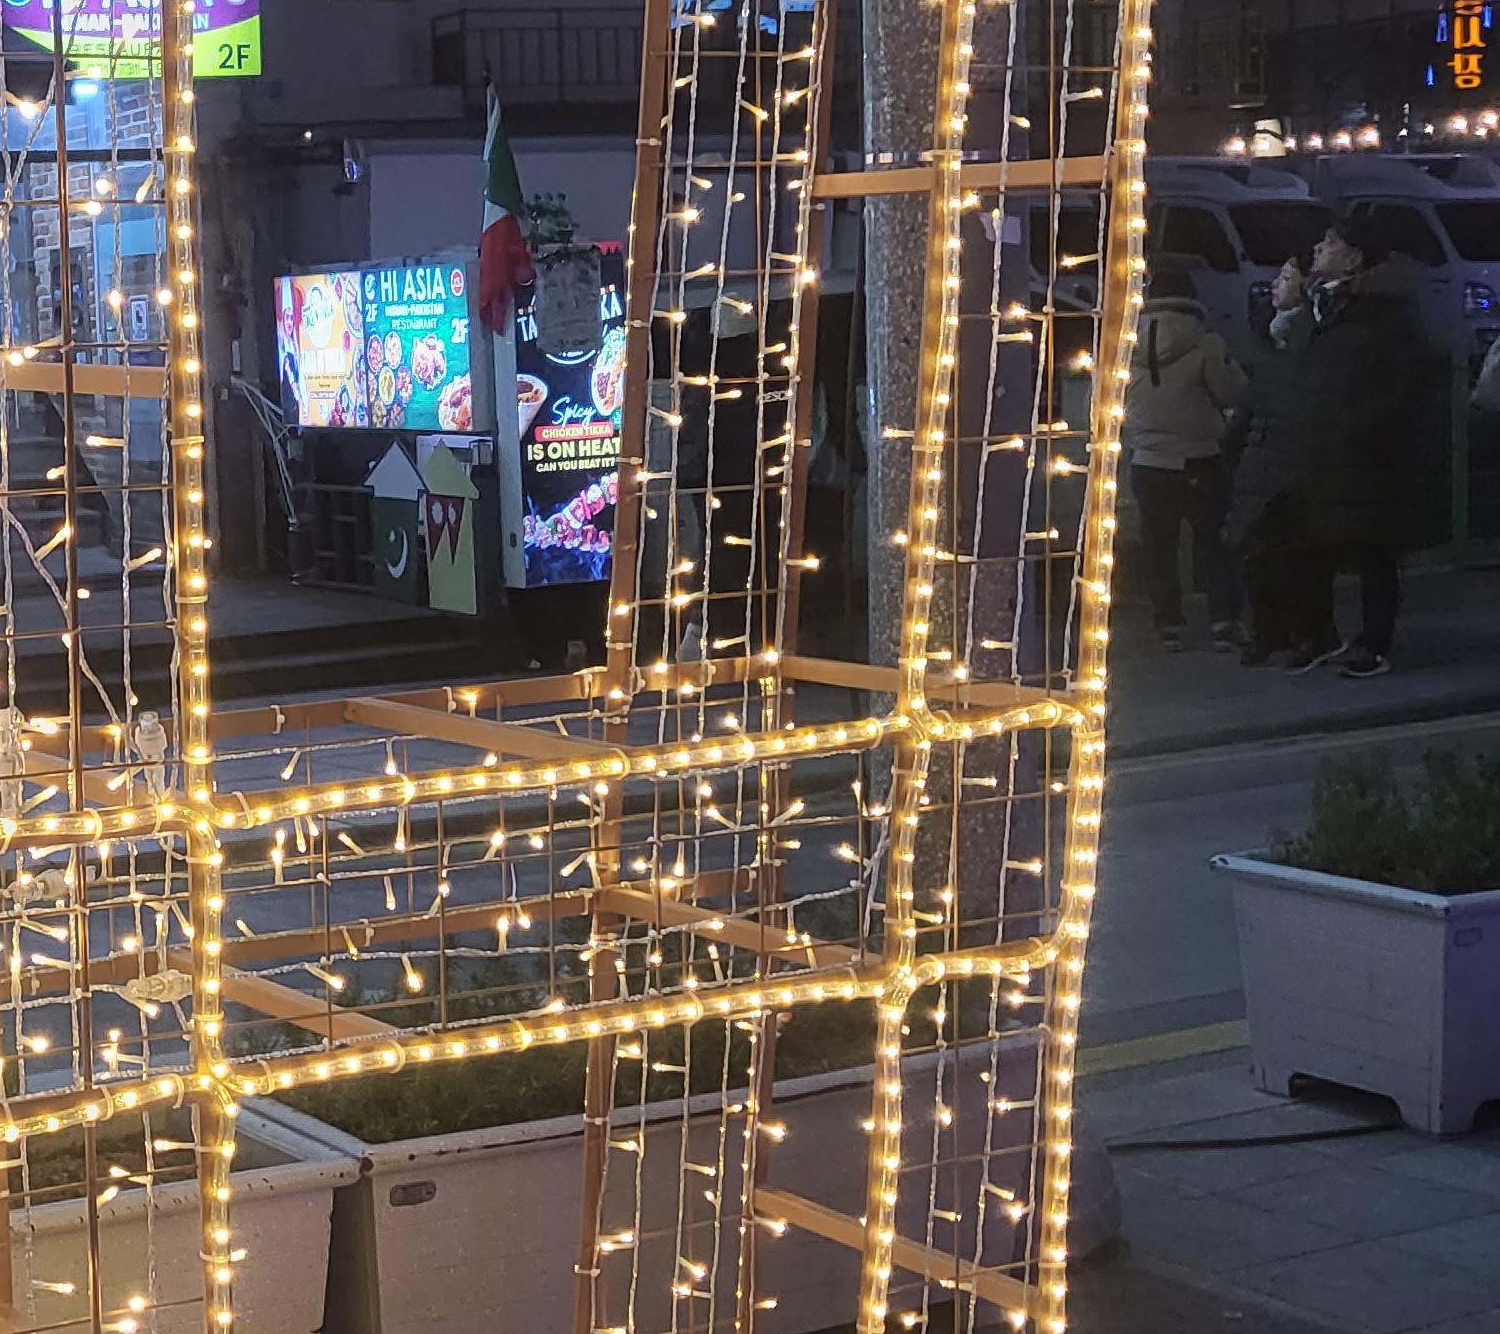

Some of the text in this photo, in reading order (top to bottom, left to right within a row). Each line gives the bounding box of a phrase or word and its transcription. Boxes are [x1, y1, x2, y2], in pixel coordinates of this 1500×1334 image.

[218, 43, 251, 70] 2F
[380, 267, 447, 303] HI ASIA
[364, 303, 378, 323] 2F
[391, 318, 438, 330] RESTAURANT
[551, 396, 597, 428] Spicy
[542, 427, 581, 439] CHICKEN
[527, 437, 620, 461] IS ON HEAT
[536, 462, 557, 472] CAN
[558, 460, 578, 471] YOU
[579, 458, 600, 469] BEAT
